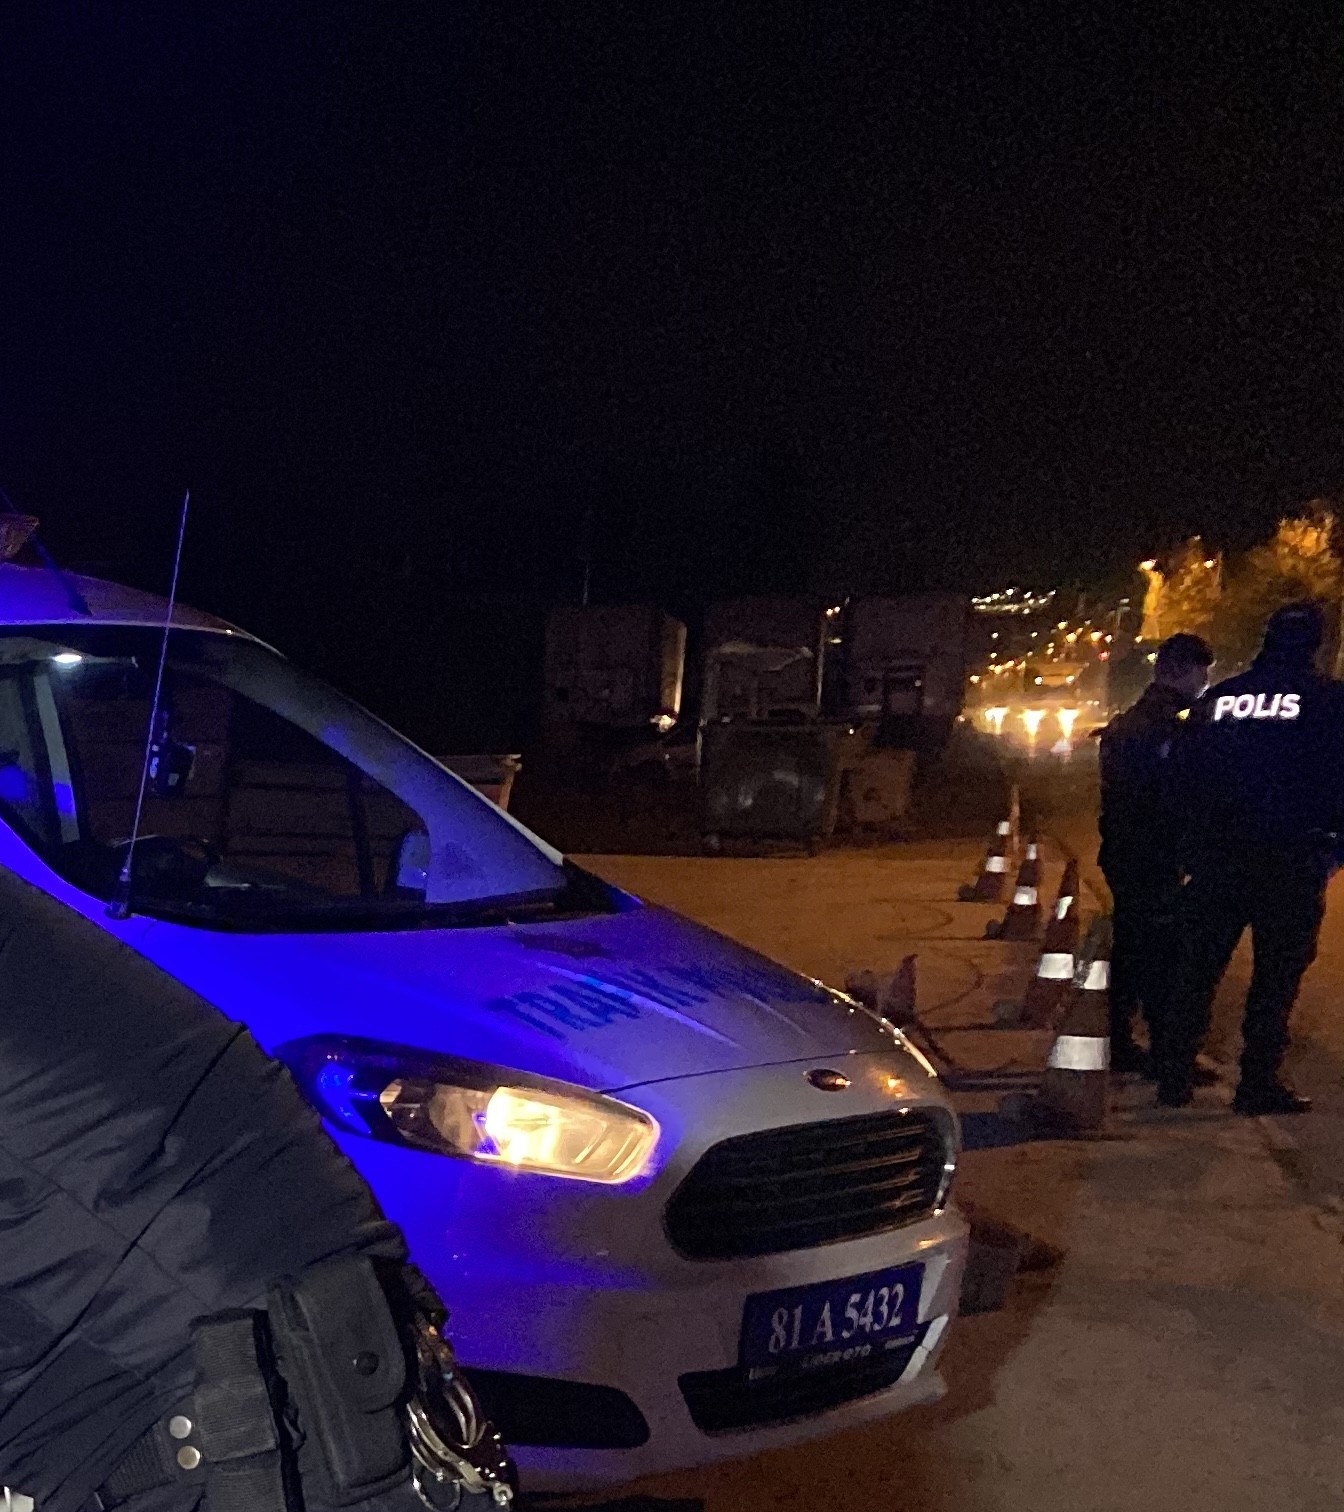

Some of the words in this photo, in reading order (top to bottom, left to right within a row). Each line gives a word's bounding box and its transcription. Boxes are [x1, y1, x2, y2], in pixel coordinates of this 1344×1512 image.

[768, 1304, 803, 1353] 81
[812, 1300, 834, 1345] A
[841, 1283, 905, 1339] 5432
